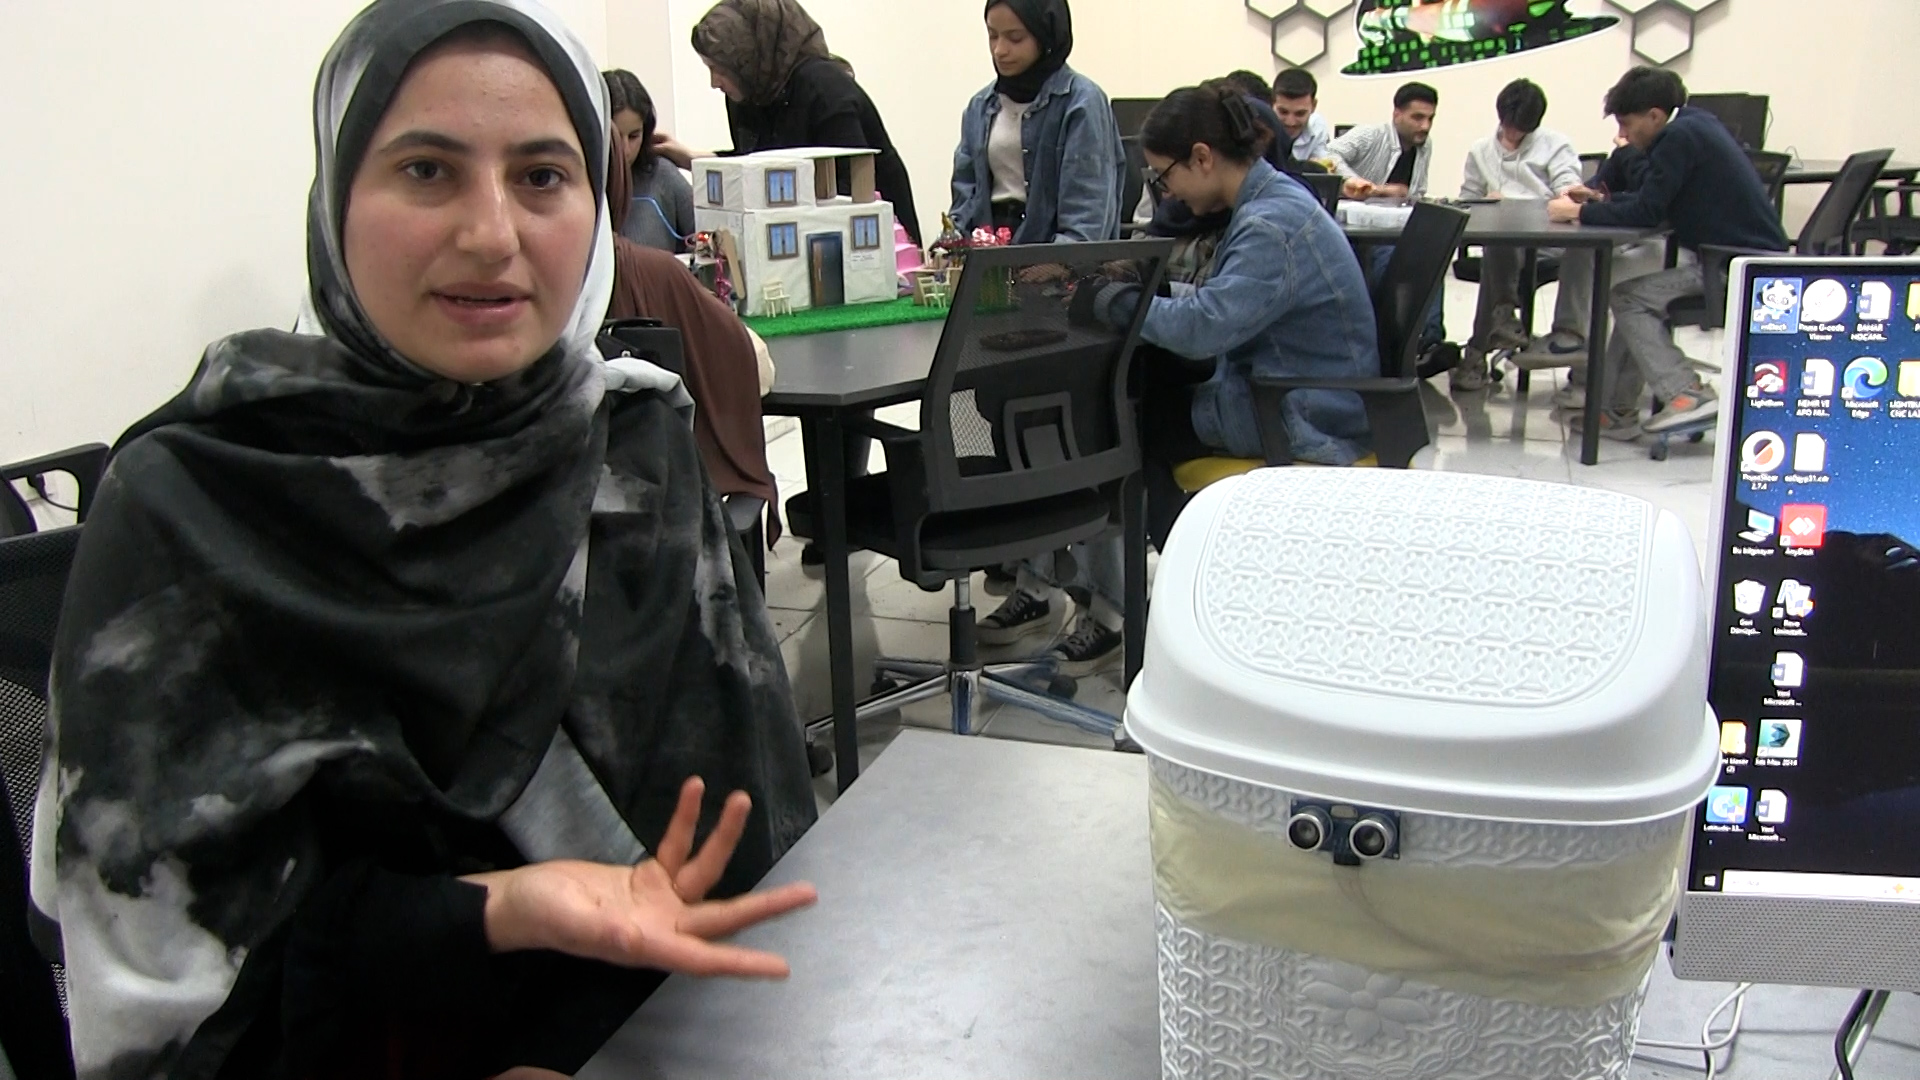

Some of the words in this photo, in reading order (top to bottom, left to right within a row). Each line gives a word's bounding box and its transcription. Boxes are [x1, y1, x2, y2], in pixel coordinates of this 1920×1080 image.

[1819, 323, 1845, 332] G-code
[1809, 333, 1833, 341] Viewer
[1845, 400, 1878, 408] Microsoft
[1851, 409, 1869, 419] Edge
[1732, 546, 1742, 555] Bu
[1784, 547, 1814, 557] AnyDesk
